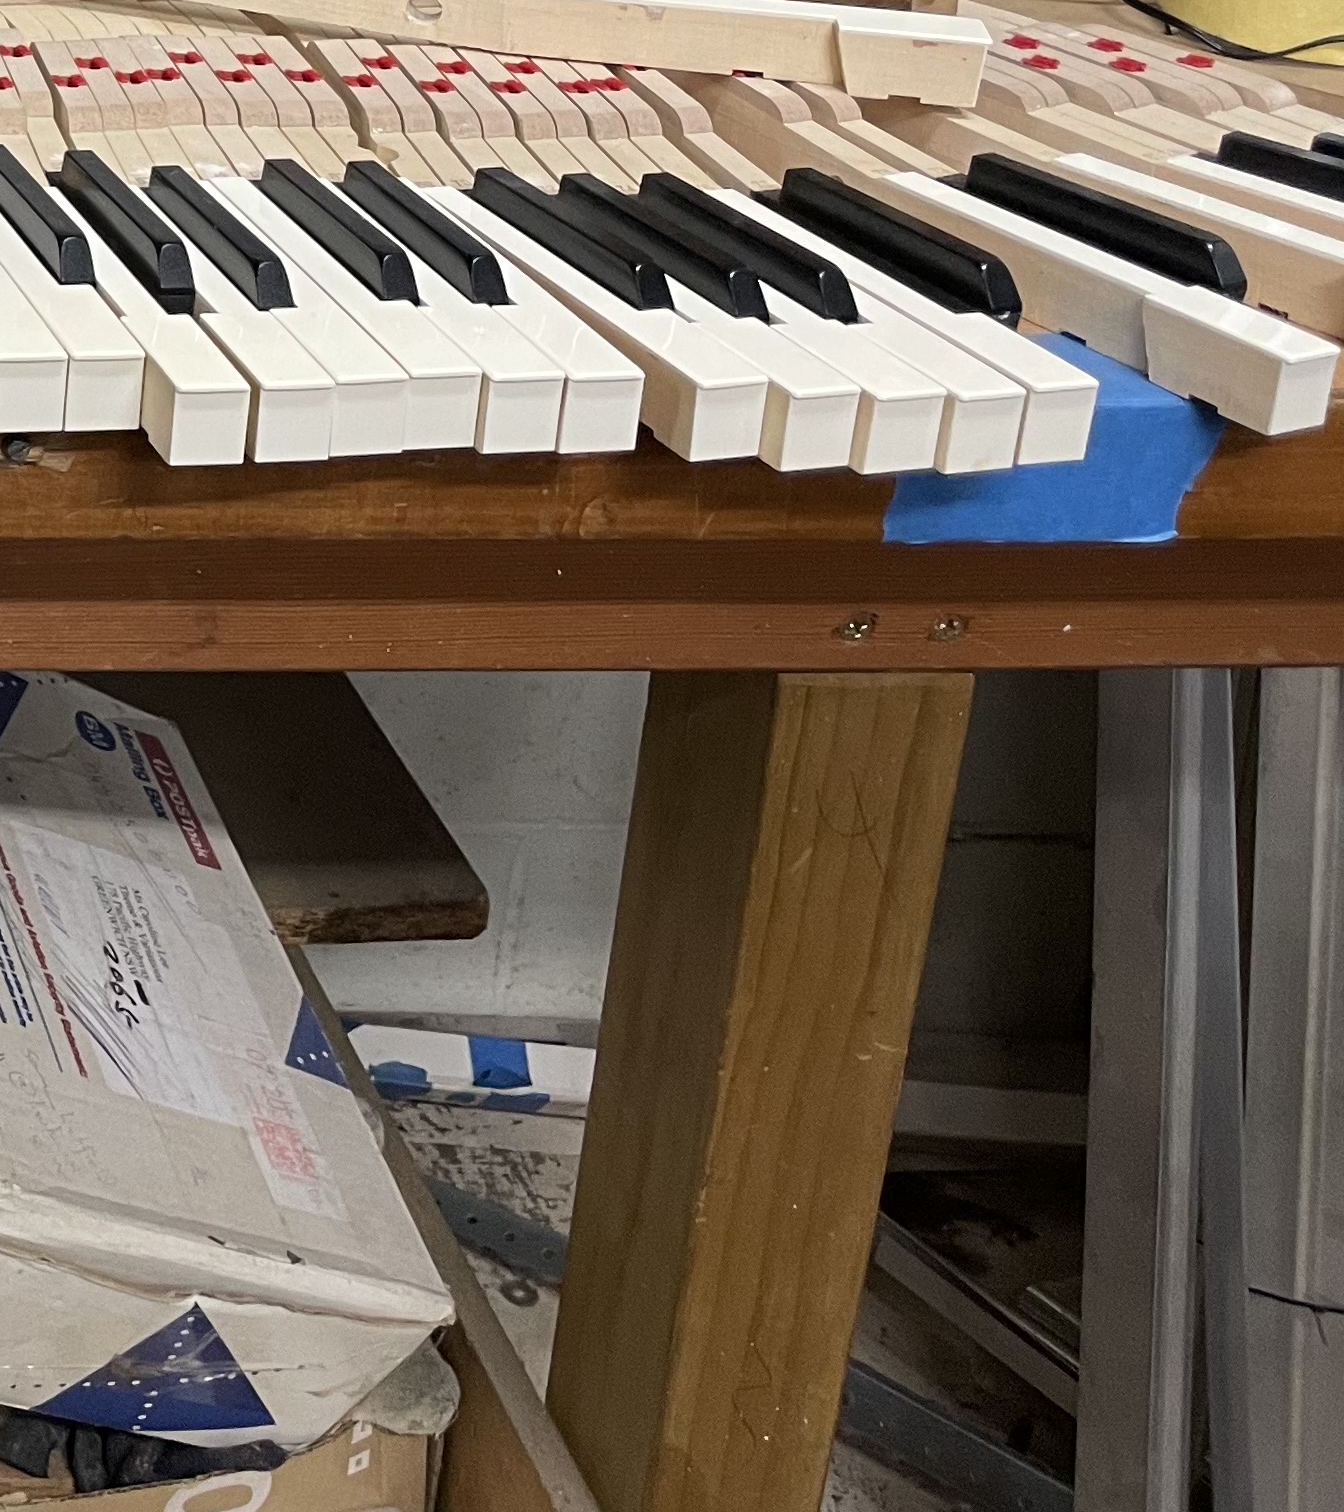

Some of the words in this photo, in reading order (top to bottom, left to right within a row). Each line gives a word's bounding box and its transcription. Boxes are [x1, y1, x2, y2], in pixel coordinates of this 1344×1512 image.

[80, 714, 108, 749] BM
[113, 720, 149, 782] Mailing
[143, 782, 170, 822] Box
[91, 875, 126, 948] GREENWICH
[103, 939, 141, 1030] 2065
